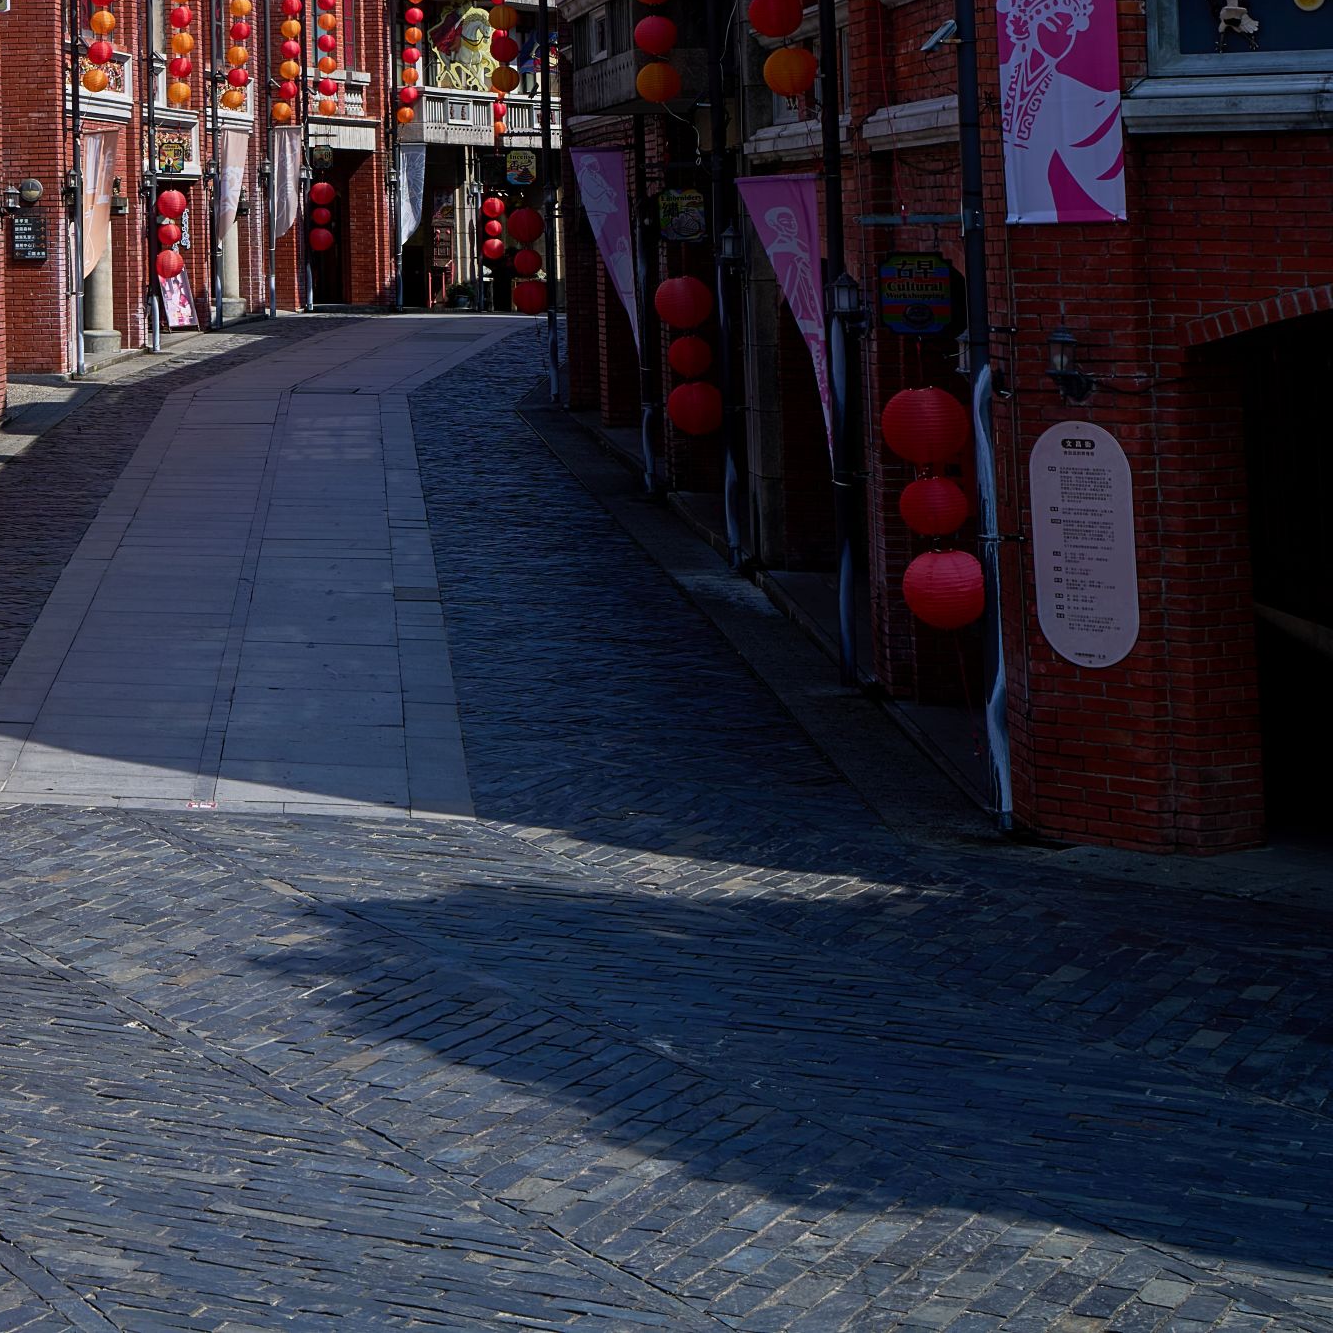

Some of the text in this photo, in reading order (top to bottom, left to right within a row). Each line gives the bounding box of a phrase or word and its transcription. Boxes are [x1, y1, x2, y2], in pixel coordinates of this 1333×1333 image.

[893, 259, 936, 280] 古早
[886, 281, 943, 292] Cultural
[1064, 439, 1093, 449] 文昌街
